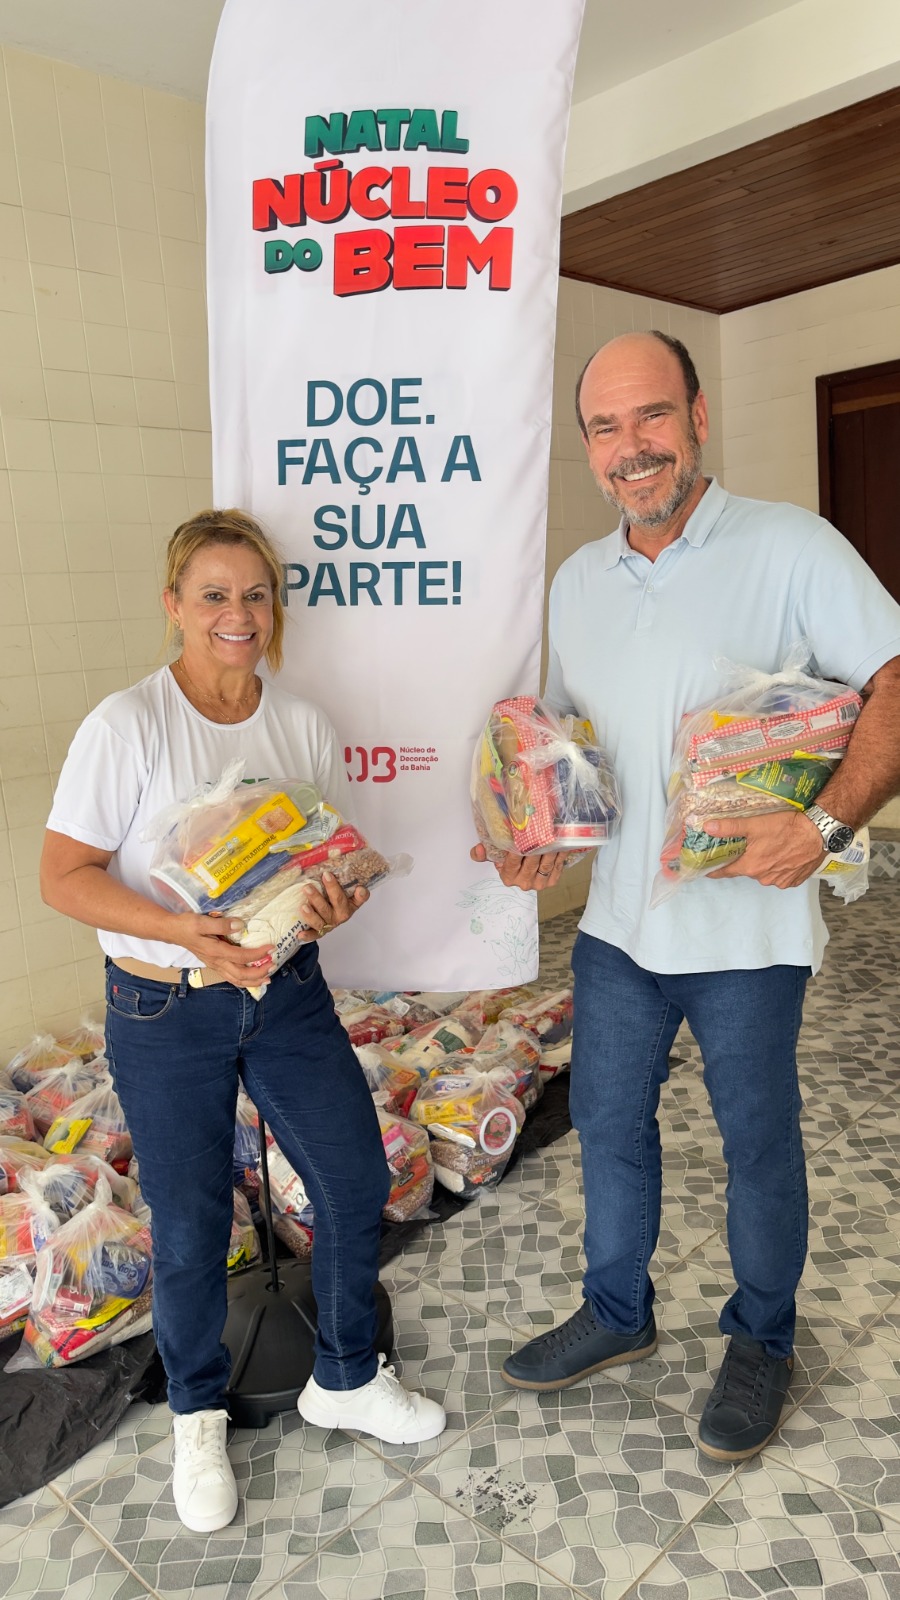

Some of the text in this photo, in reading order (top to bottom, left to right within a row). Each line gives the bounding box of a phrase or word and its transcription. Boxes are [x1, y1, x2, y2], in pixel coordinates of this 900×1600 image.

[304, 109, 469, 158] NATAL
[252, 159, 518, 232] NÚCLEO
[264, 225, 513, 297] DO BEM
[307, 378, 435, 427] DOE.
[277, 435, 482, 495] FAÇA A
[313, 504, 427, 550] SUA
[282, 561, 461, 607] PARTE!
[400, 755, 438, 763] Decoração
[214, 859, 233, 878] CREAM
[219, 861, 244, 884] CRACKER
[243, 834, 277, 863] TRADICIONAL
